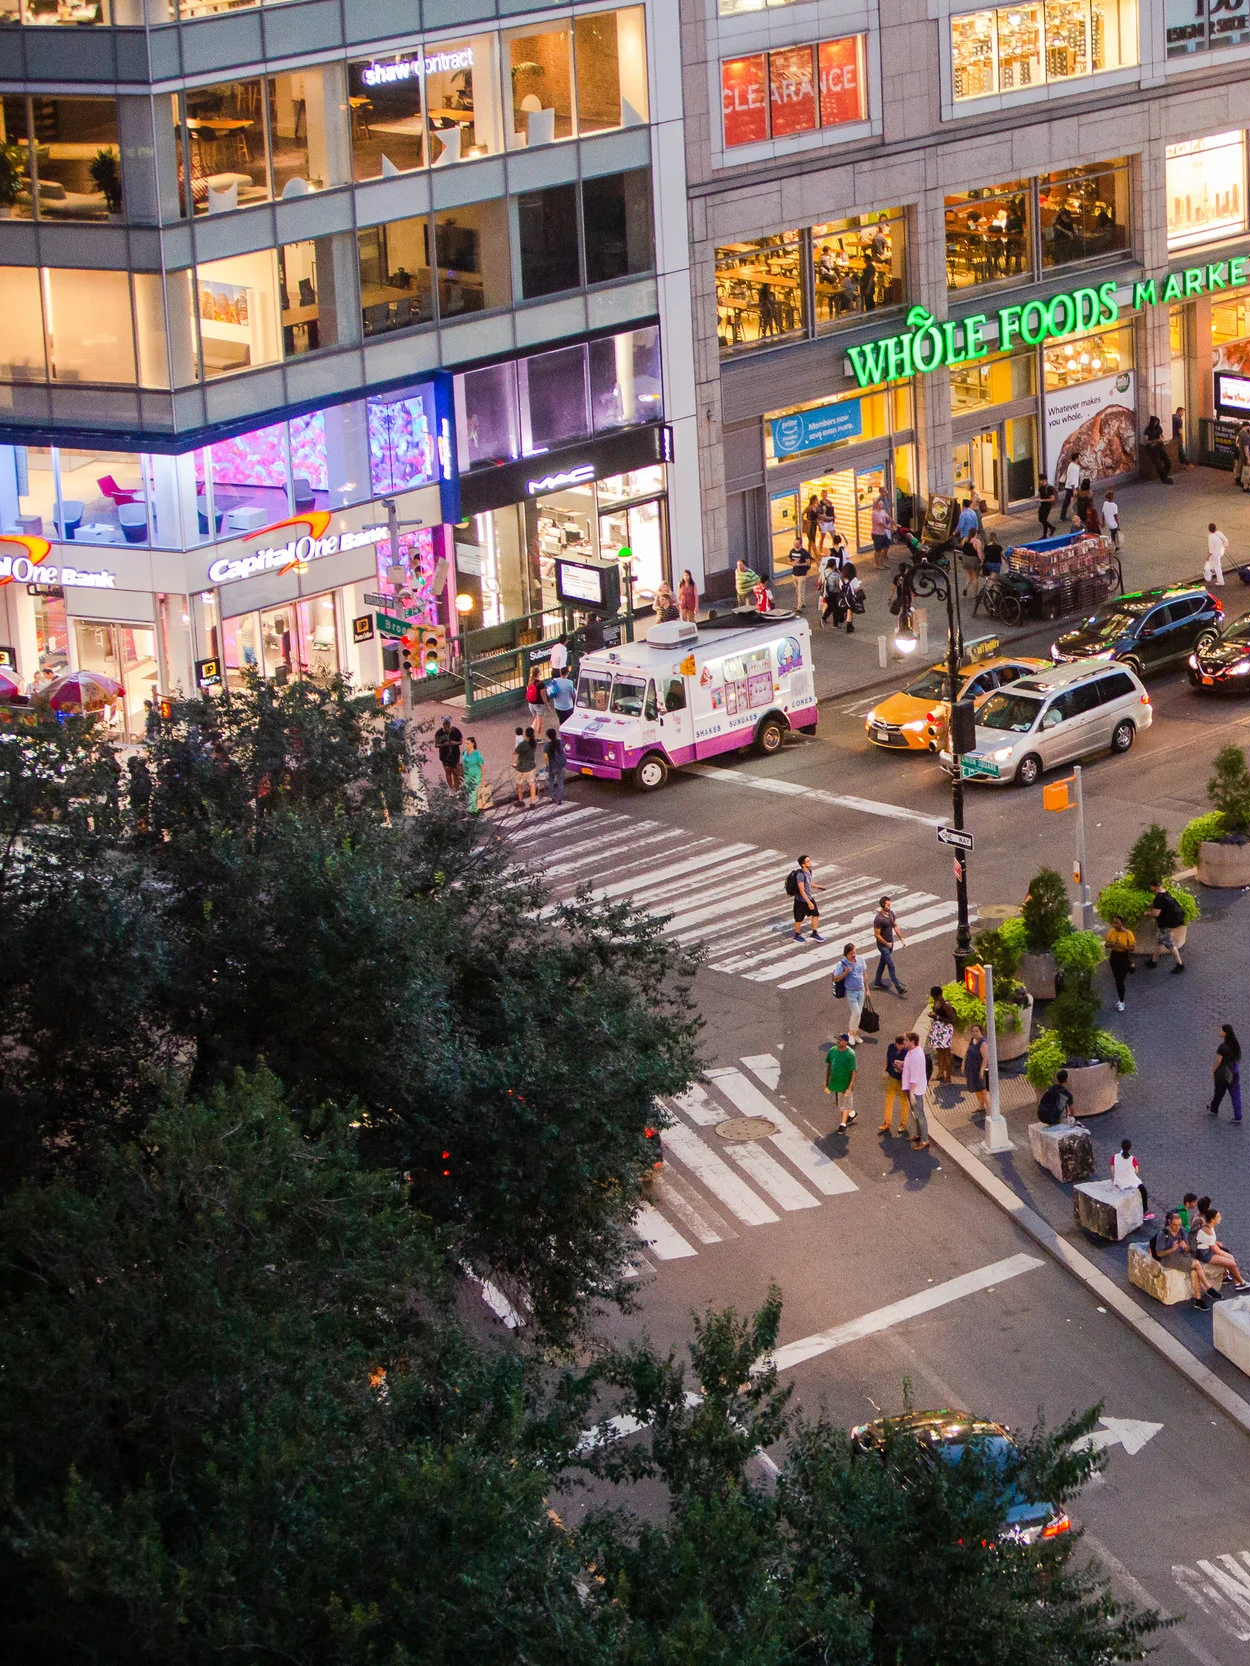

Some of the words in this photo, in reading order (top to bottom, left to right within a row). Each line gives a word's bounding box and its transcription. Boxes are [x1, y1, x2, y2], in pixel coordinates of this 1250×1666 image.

[364, 62, 410, 86] shaw
[413, 47, 474, 76] contract
[722, 64, 857, 114] CLEARANCE
[847, 305, 988, 388] WHOLE
[998, 280, 1120, 352] FOODS
[1047, 402, 1080, 416] Whatever
[1080, 396, 1101, 408] makes
[808, 418, 836, 431] Members
[837, 415, 849, 423] now
[1048, 420, 1060, 429] you
[1061, 412, 1083, 423] whole.
[823, 428, 837, 436] even
[339, 526, 389, 551] Bank
[61, 567, 115, 588] Bank
[385, 619, 407, 634] Broa
[529, 649, 552, 661] Subw
[695, 725, 721, 738] SHAKES
[729, 713, 758, 728] SUNDAES
[791, 696, 813, 708] CONES
[978, 759, 997, 772] SQUARE
[941, 832, 953, 841] ONE
[958, 835, 970, 844] WAY
